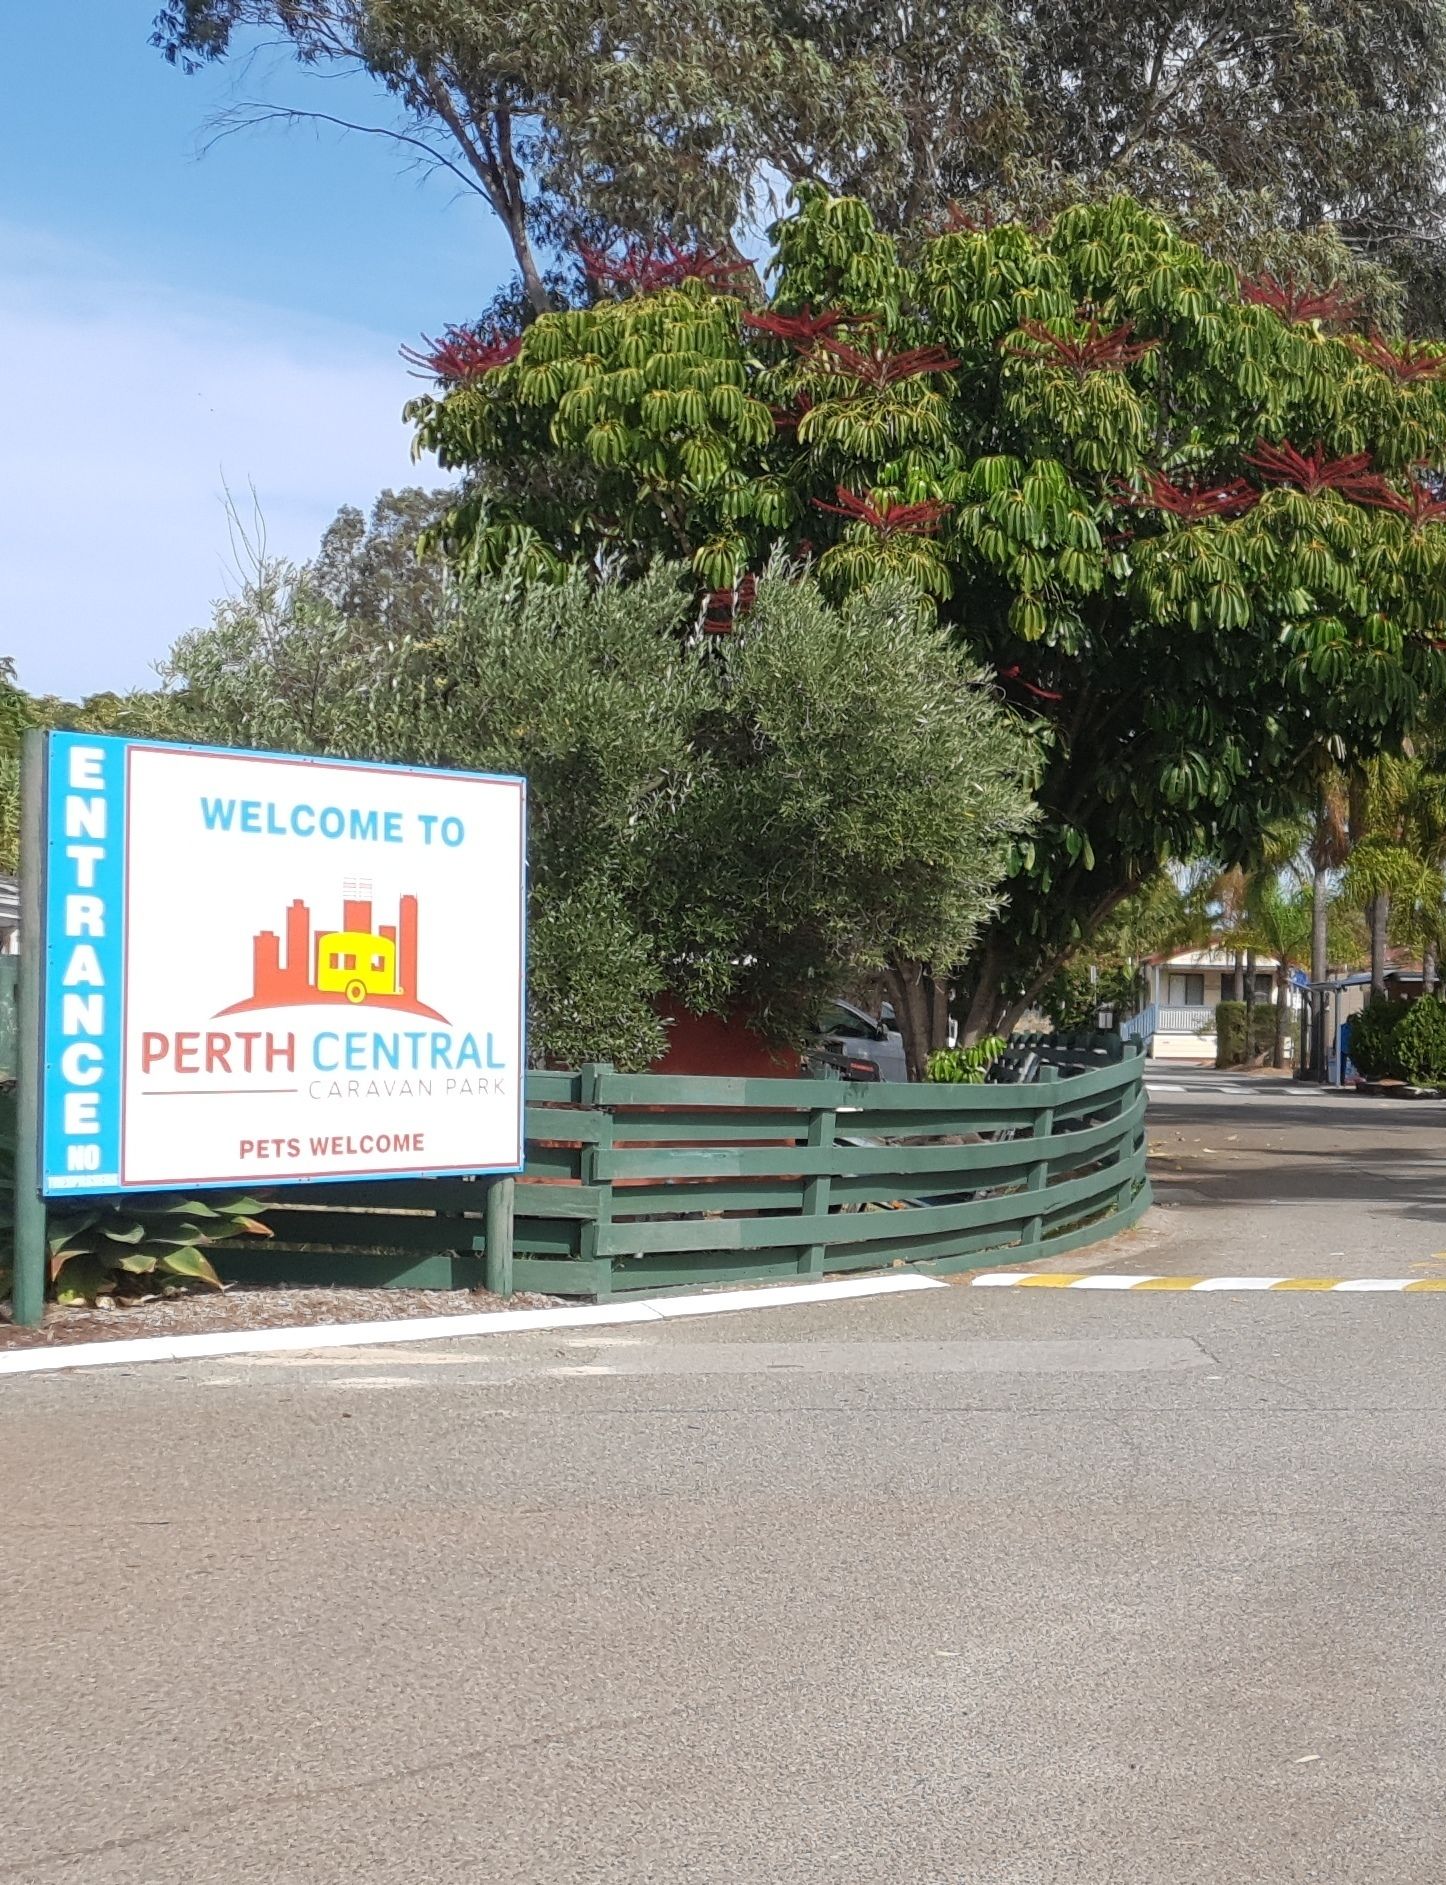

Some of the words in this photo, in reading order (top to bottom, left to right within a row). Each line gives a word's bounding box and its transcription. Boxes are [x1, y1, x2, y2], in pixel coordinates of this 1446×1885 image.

[200, 797, 404, 843] WELCOME
[417, 815, 465, 847] TO
[62, 745, 107, 1135] ENTRANCE
[142, 1031, 296, 1075] PERTH
[312, 1031, 506, 1073] CENTRAL
[308, 1077, 433, 1100] CARAVAN
[446, 1077, 506, 1096] PARK
[67, 1144, 101, 1172] NO
[239, 1138, 302, 1160] PETS
[310, 1132, 426, 1156] WELCOME
